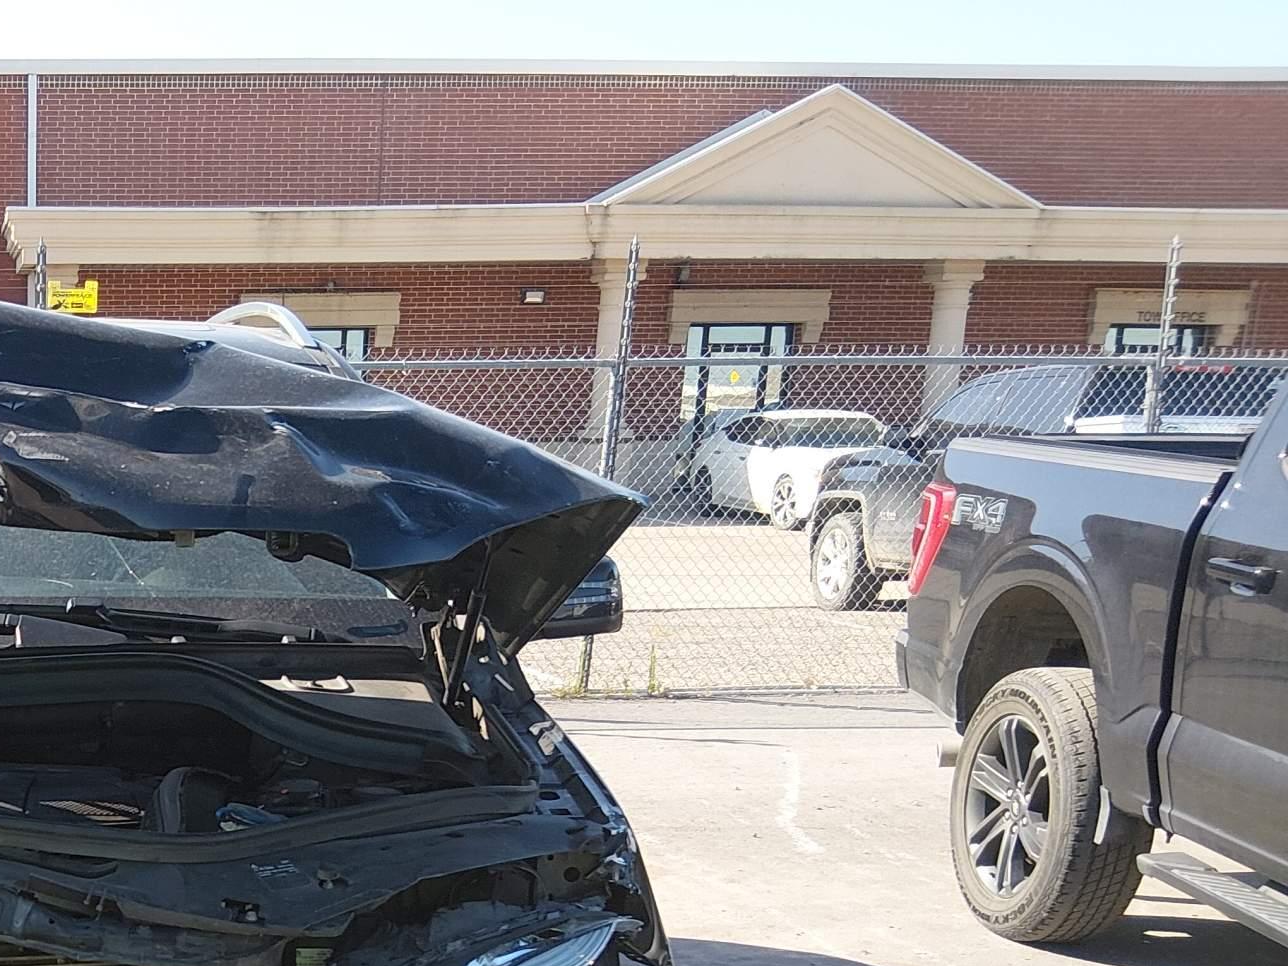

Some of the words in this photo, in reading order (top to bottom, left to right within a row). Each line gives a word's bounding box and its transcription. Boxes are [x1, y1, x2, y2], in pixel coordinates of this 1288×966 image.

[1170, 311, 1206, 322] FFICE
[951, 493, 1009, 526] FX4
[1009, 688, 1057, 760] MOUNTAIN
